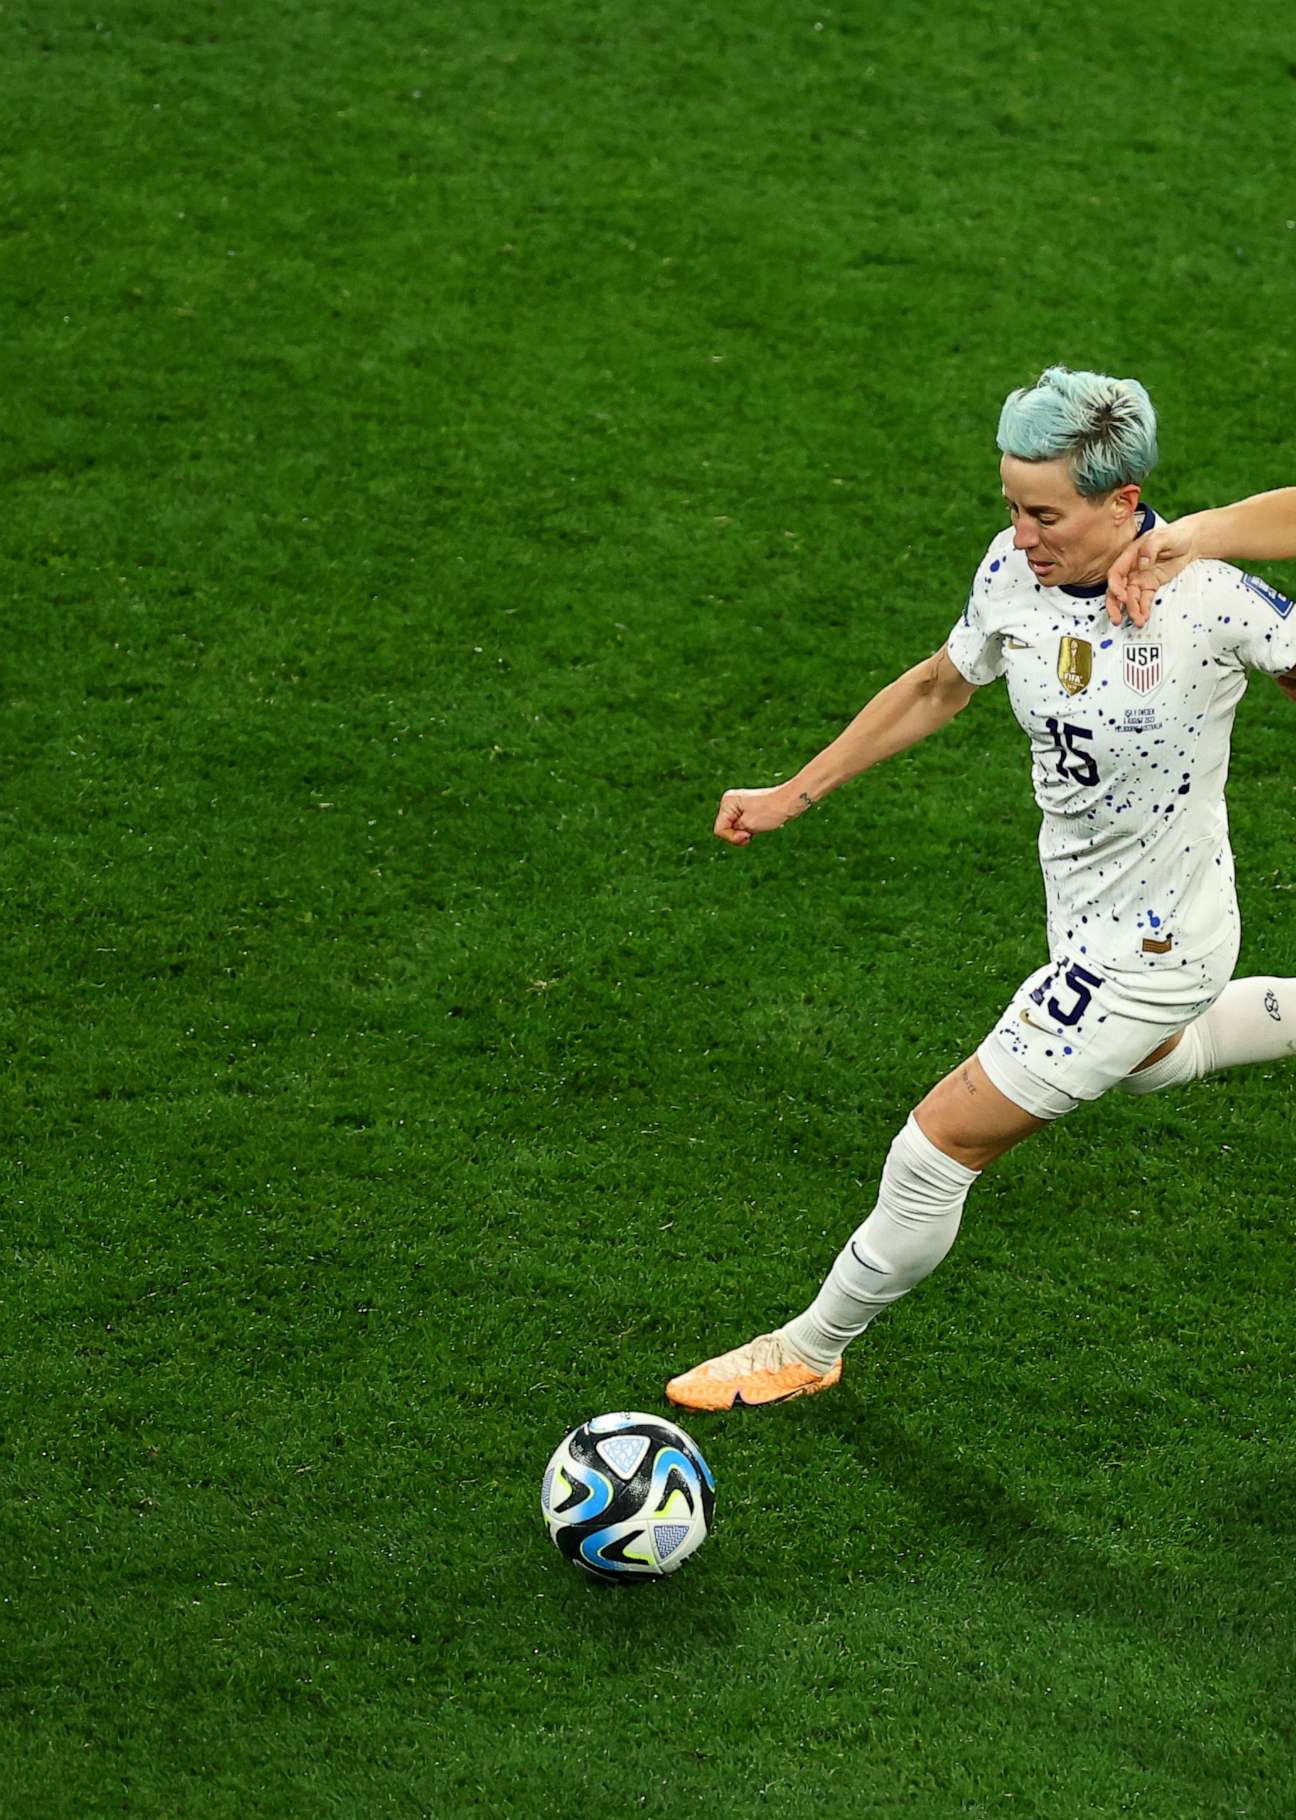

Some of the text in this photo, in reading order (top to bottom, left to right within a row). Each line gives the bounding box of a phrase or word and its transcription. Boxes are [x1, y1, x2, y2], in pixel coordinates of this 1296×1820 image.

[1126, 647, 1160, 667] USA
[1045, 717, 1101, 787] 15
[1028, 956, 1101, 1026] 15
